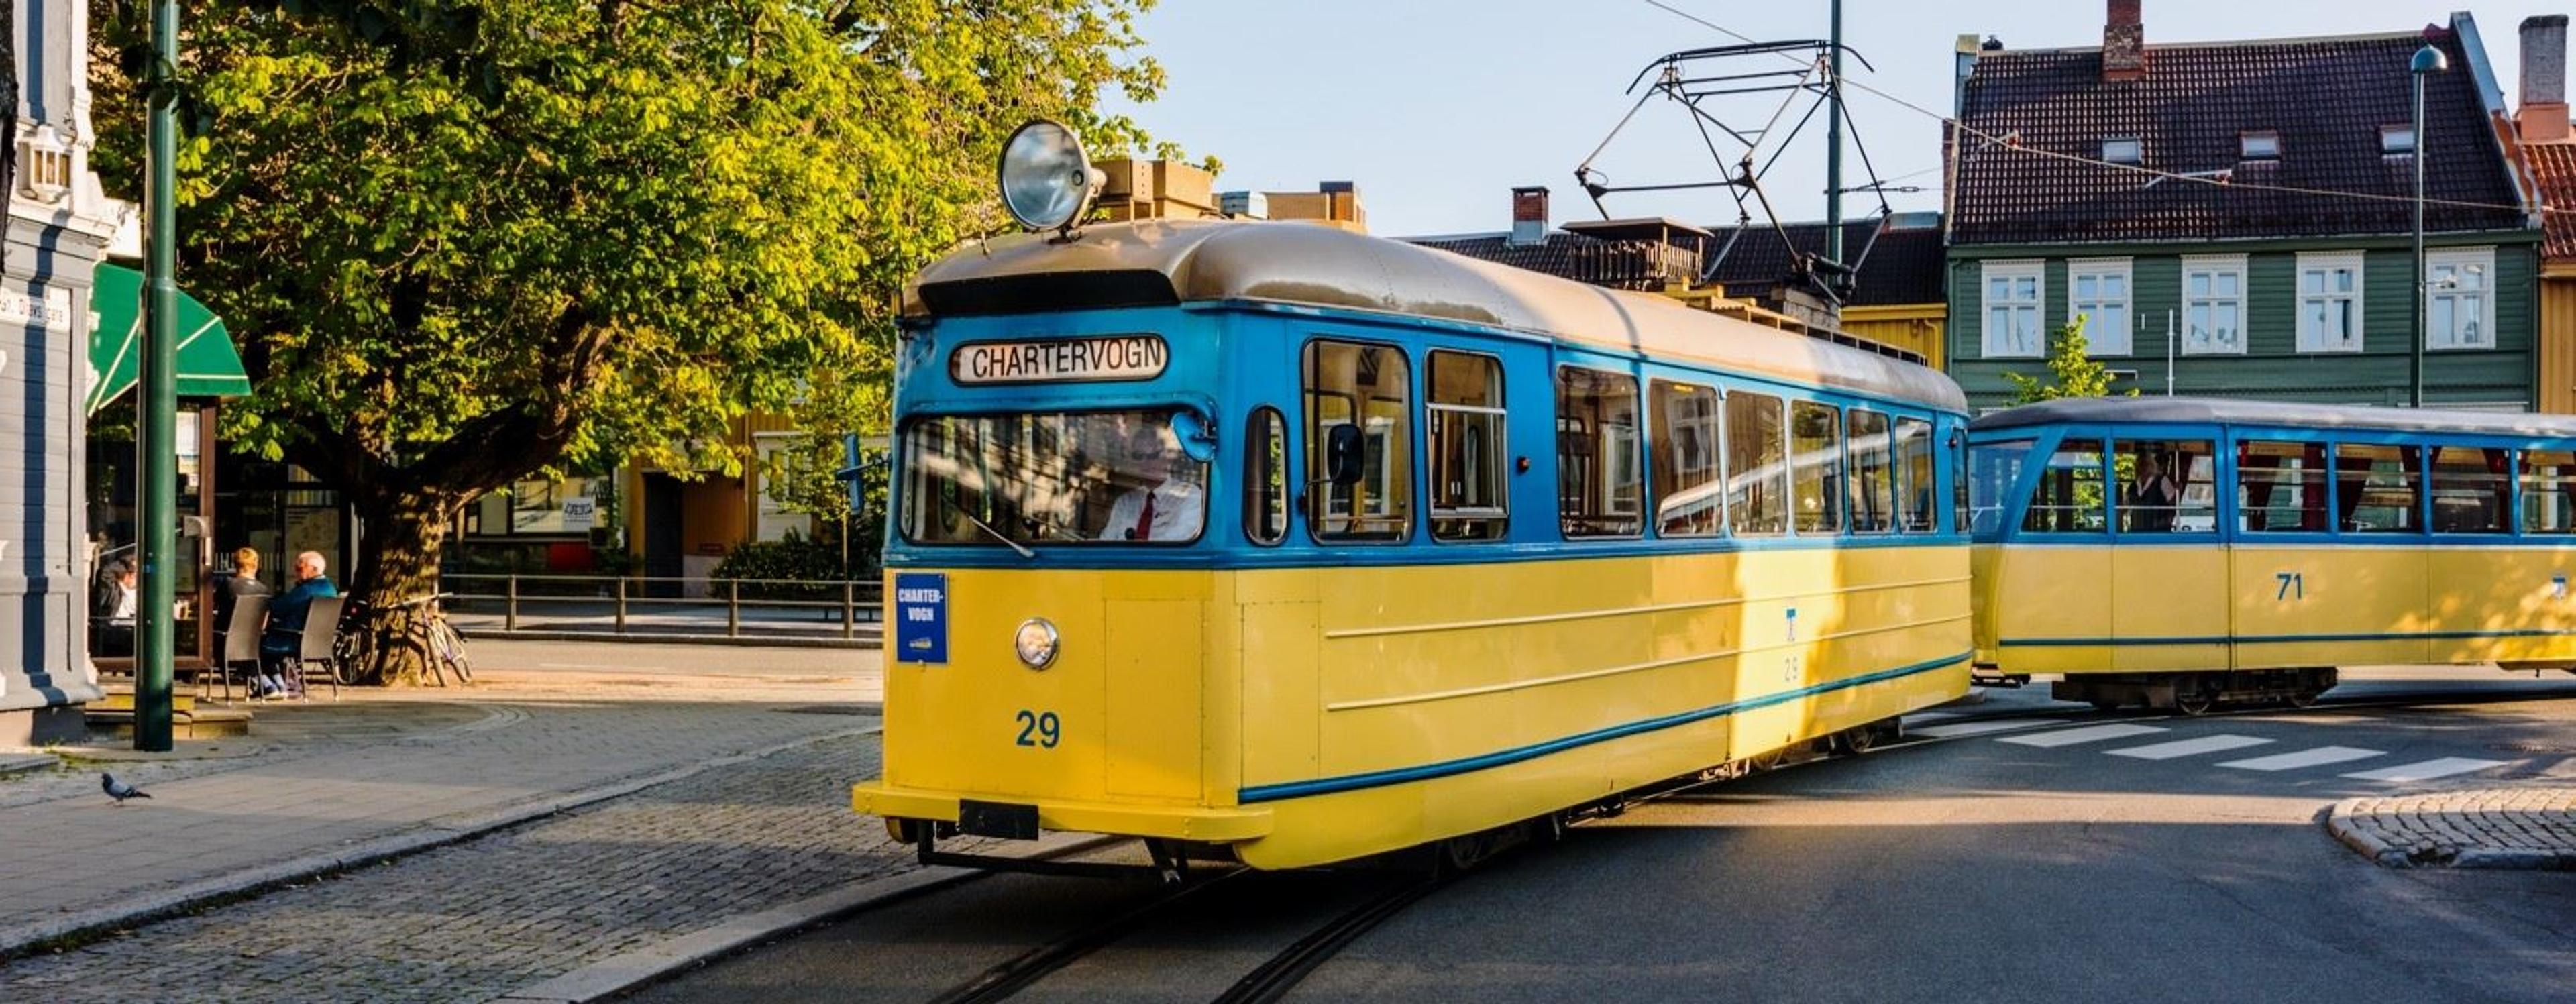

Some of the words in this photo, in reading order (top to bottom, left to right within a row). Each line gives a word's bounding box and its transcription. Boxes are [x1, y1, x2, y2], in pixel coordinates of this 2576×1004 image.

[19, 298, 42, 318] Oavs
[973, 337, 1161, 378] CHARTERVOGN
[898, 588, 943, 603] CHARTER-
[2277, 573, 2302, 600] 71
[908, 606, 934, 621] VOGN
[1016, 710, 1059, 748] 29
